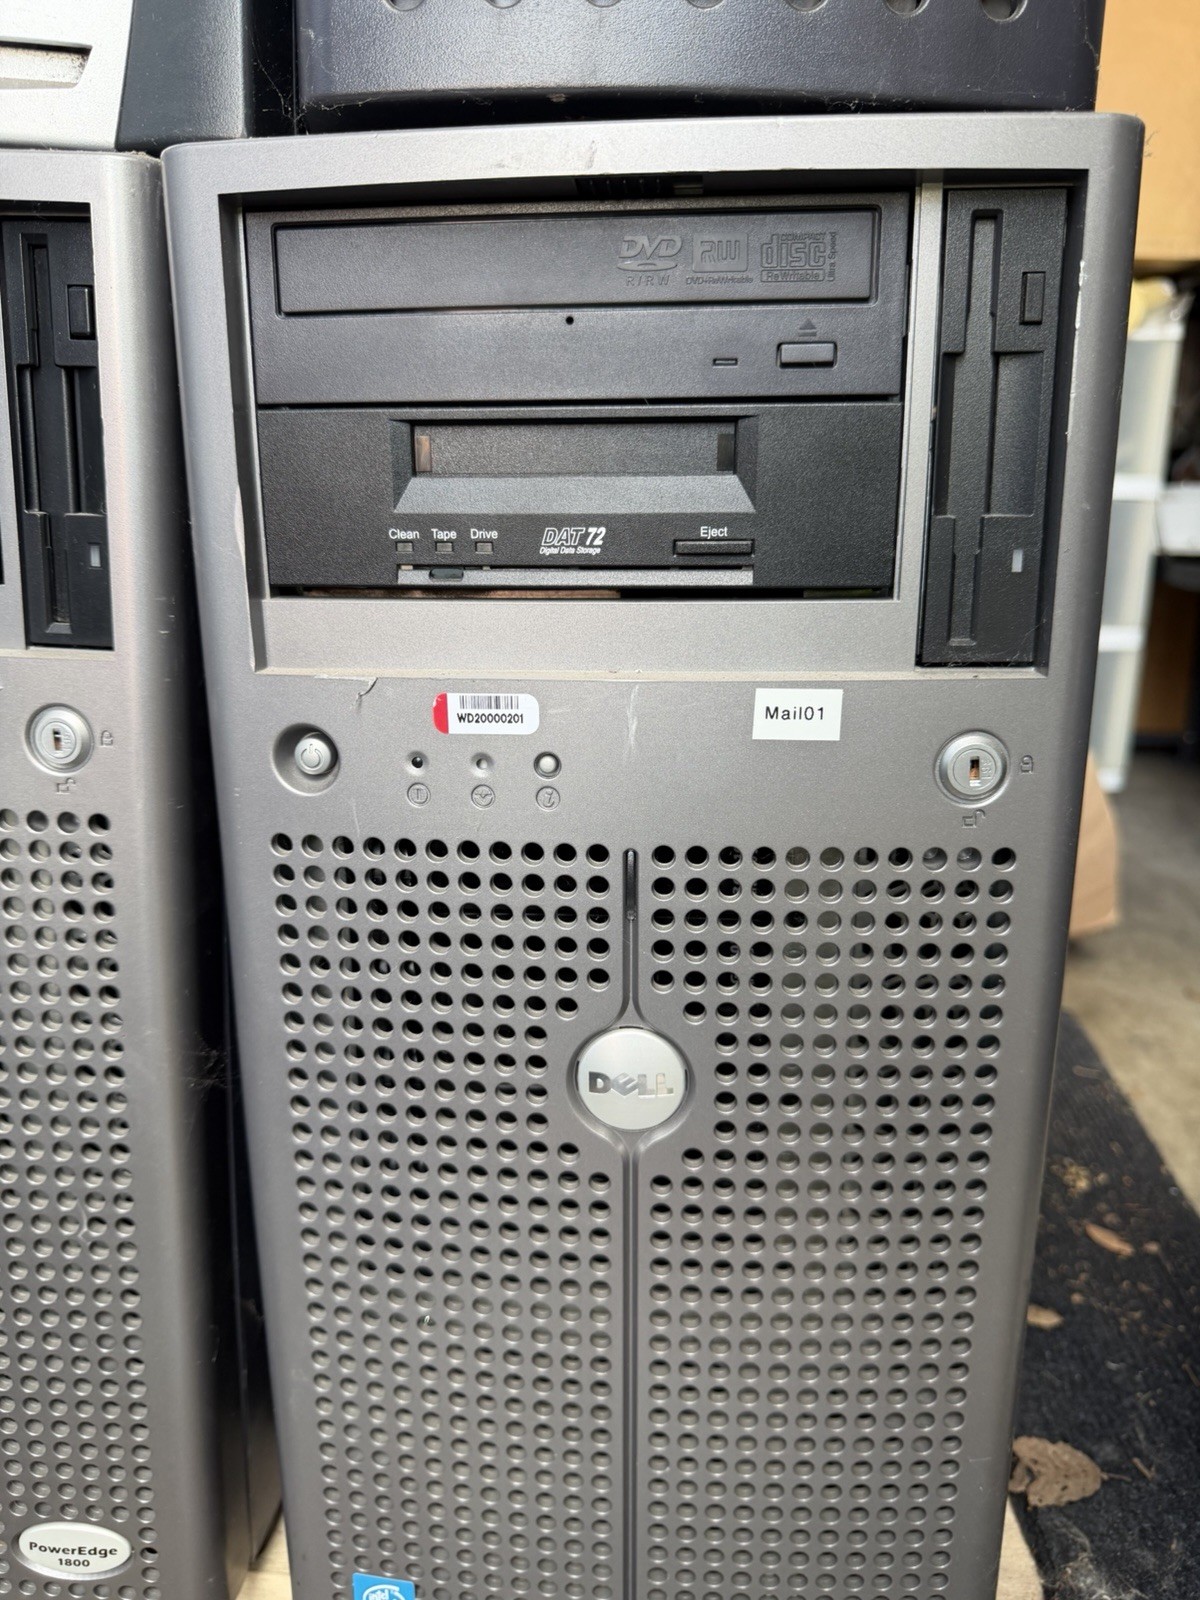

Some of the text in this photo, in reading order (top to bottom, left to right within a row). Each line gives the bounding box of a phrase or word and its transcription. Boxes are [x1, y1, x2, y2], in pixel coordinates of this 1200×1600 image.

[617, 235, 683, 260] DVD
[700, 240, 740, 263] RW
[388, 528, 420, 540] Clean
[431, 528, 457, 541] Tape
[470, 528, 498, 540] Drive
[541, 526, 607, 546] DAT 72
[700, 526, 728, 539] Eject
[539, 546, 601, 556] Digital Data Storage
[456, 712, 524, 724] WD20000201
[765, 706, 824, 721] Mail01
[588, 1070, 674, 1096] DELL
[29, 1541, 118, 1558] PowerEdge
[58, 1558, 90, 1567] 1800
